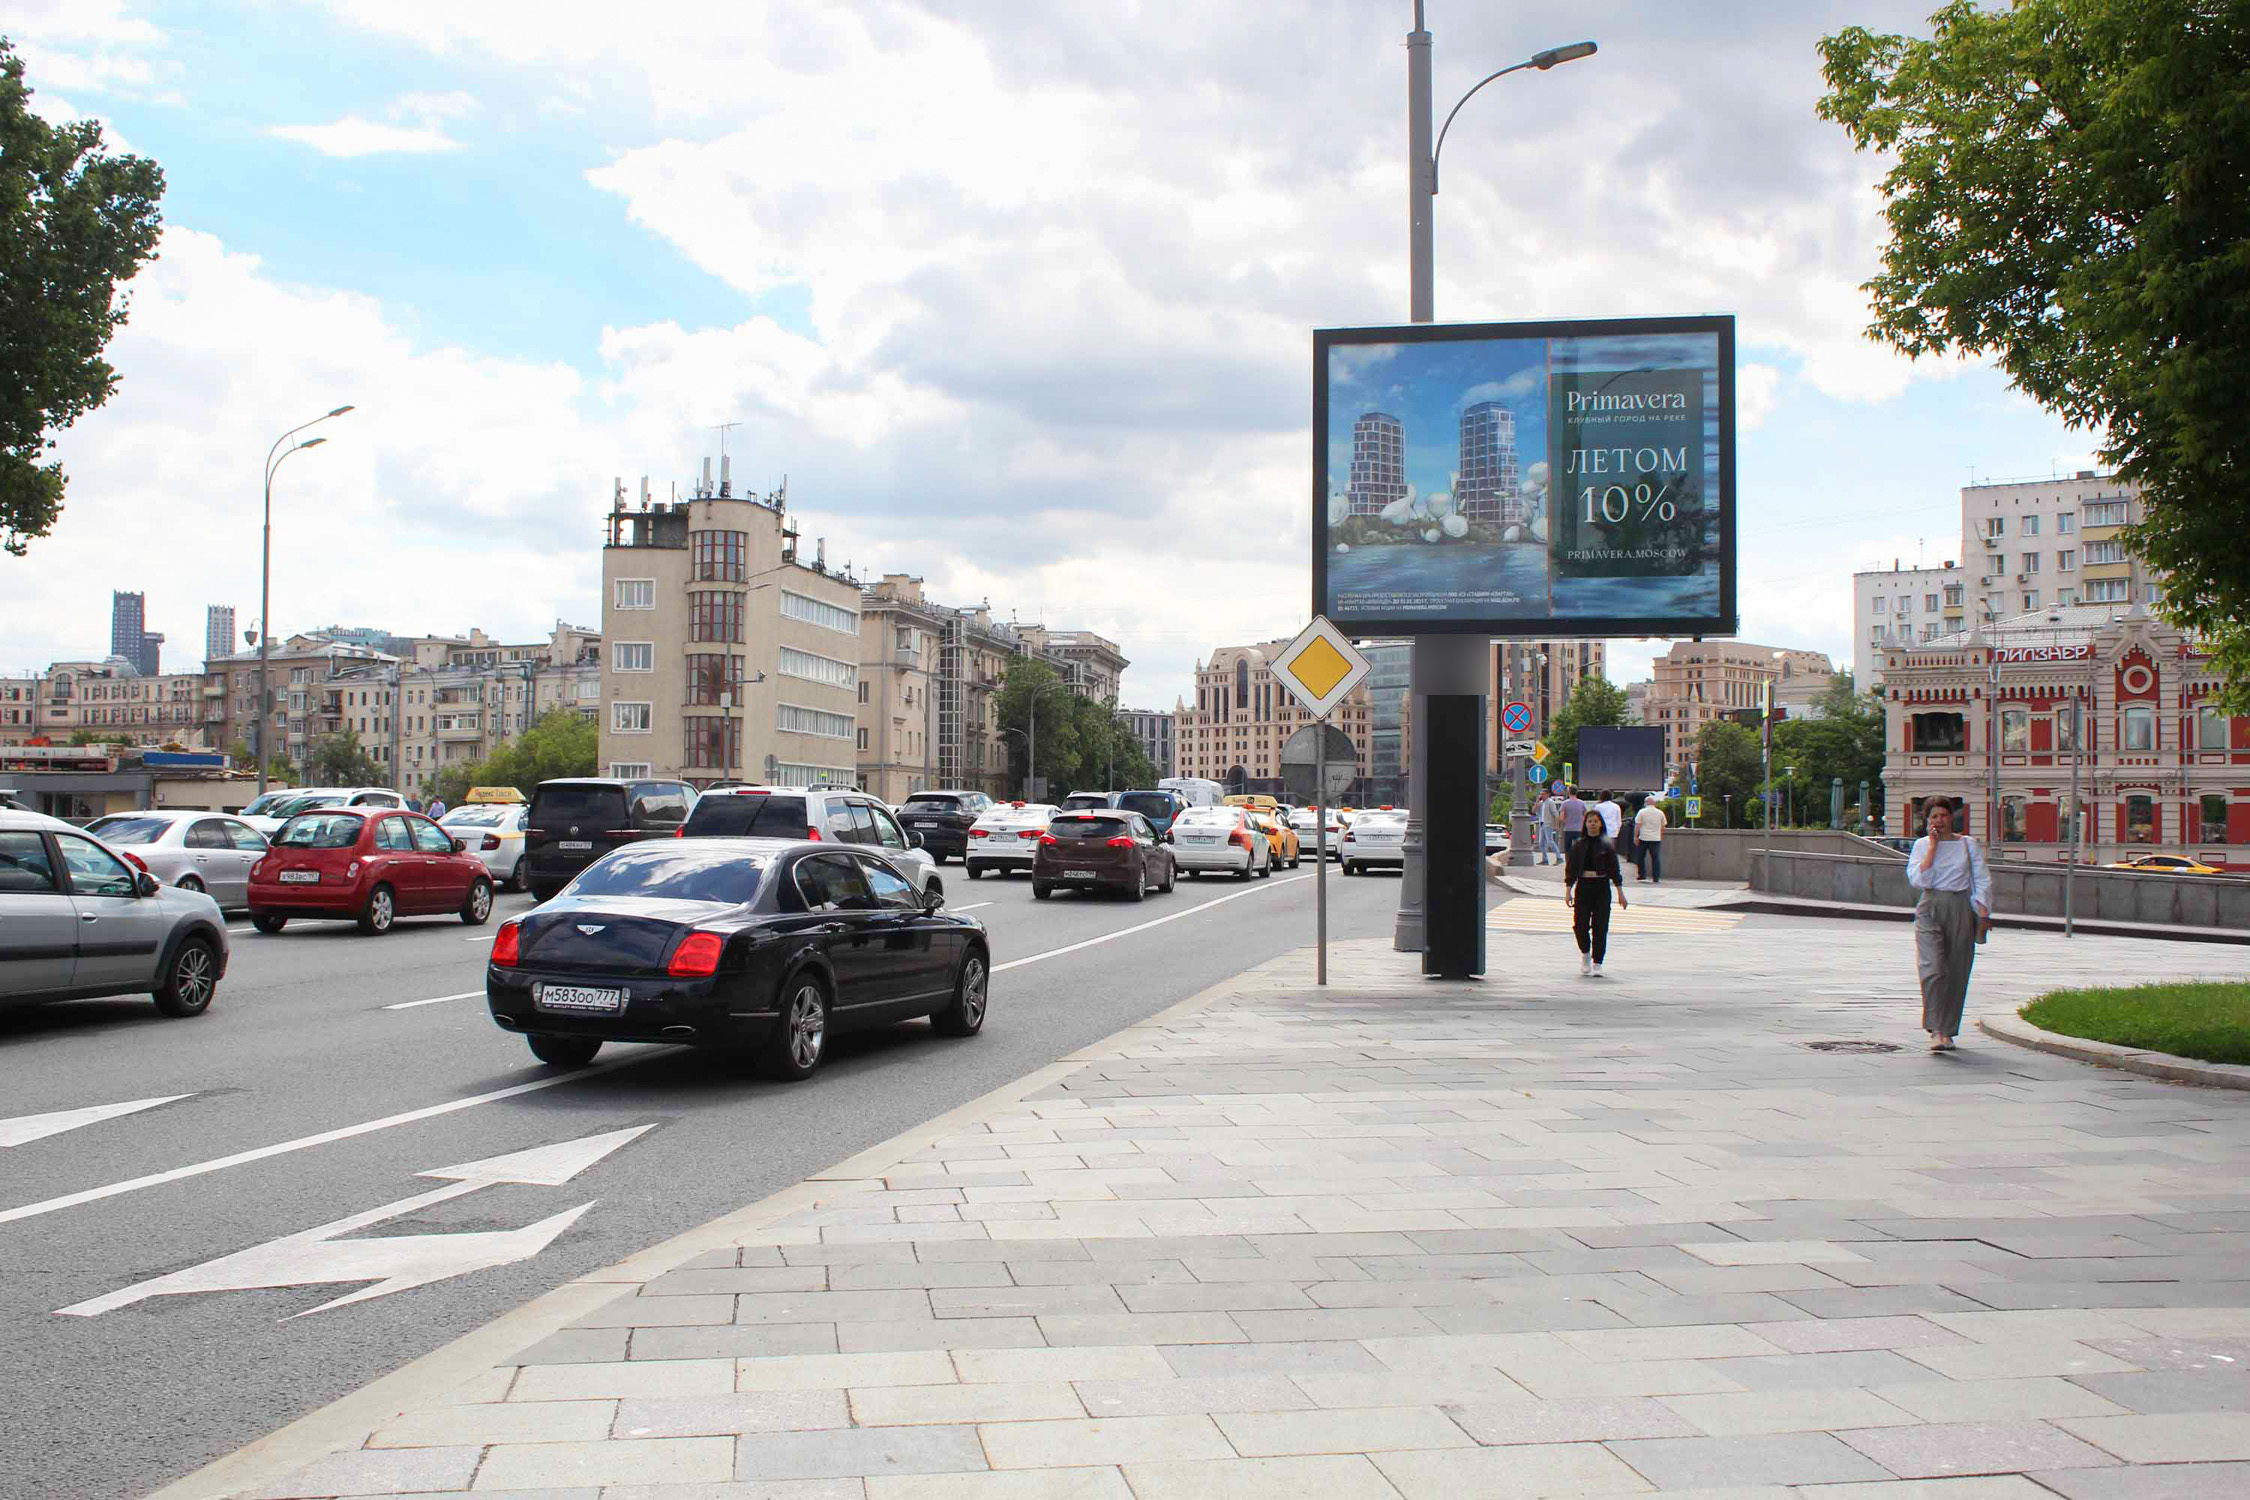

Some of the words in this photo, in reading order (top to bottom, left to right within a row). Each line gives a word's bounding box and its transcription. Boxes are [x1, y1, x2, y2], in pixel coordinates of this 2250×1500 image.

[1566, 391, 1687, 411] Primavera
[1568, 415, 1611, 424] КЛУБНЫЙ
[1614, 414, 1646, 423] ГОРОД
[1649, 414, 1661, 422] НА
[1664, 414, 1686, 422] РЕКЕ
[1567, 447, 1687, 474] ЛЕТОМ
[1579, 484, 1676, 523] 10%
[1567, 549, 1687, 559] PRIMAVERA.MOSCOW
[1994, 646, 2088, 662] ПИЛЗНЕР
[544, 988, 594, 1003] М583ОО
[597, 990, 616, 1001] 777
